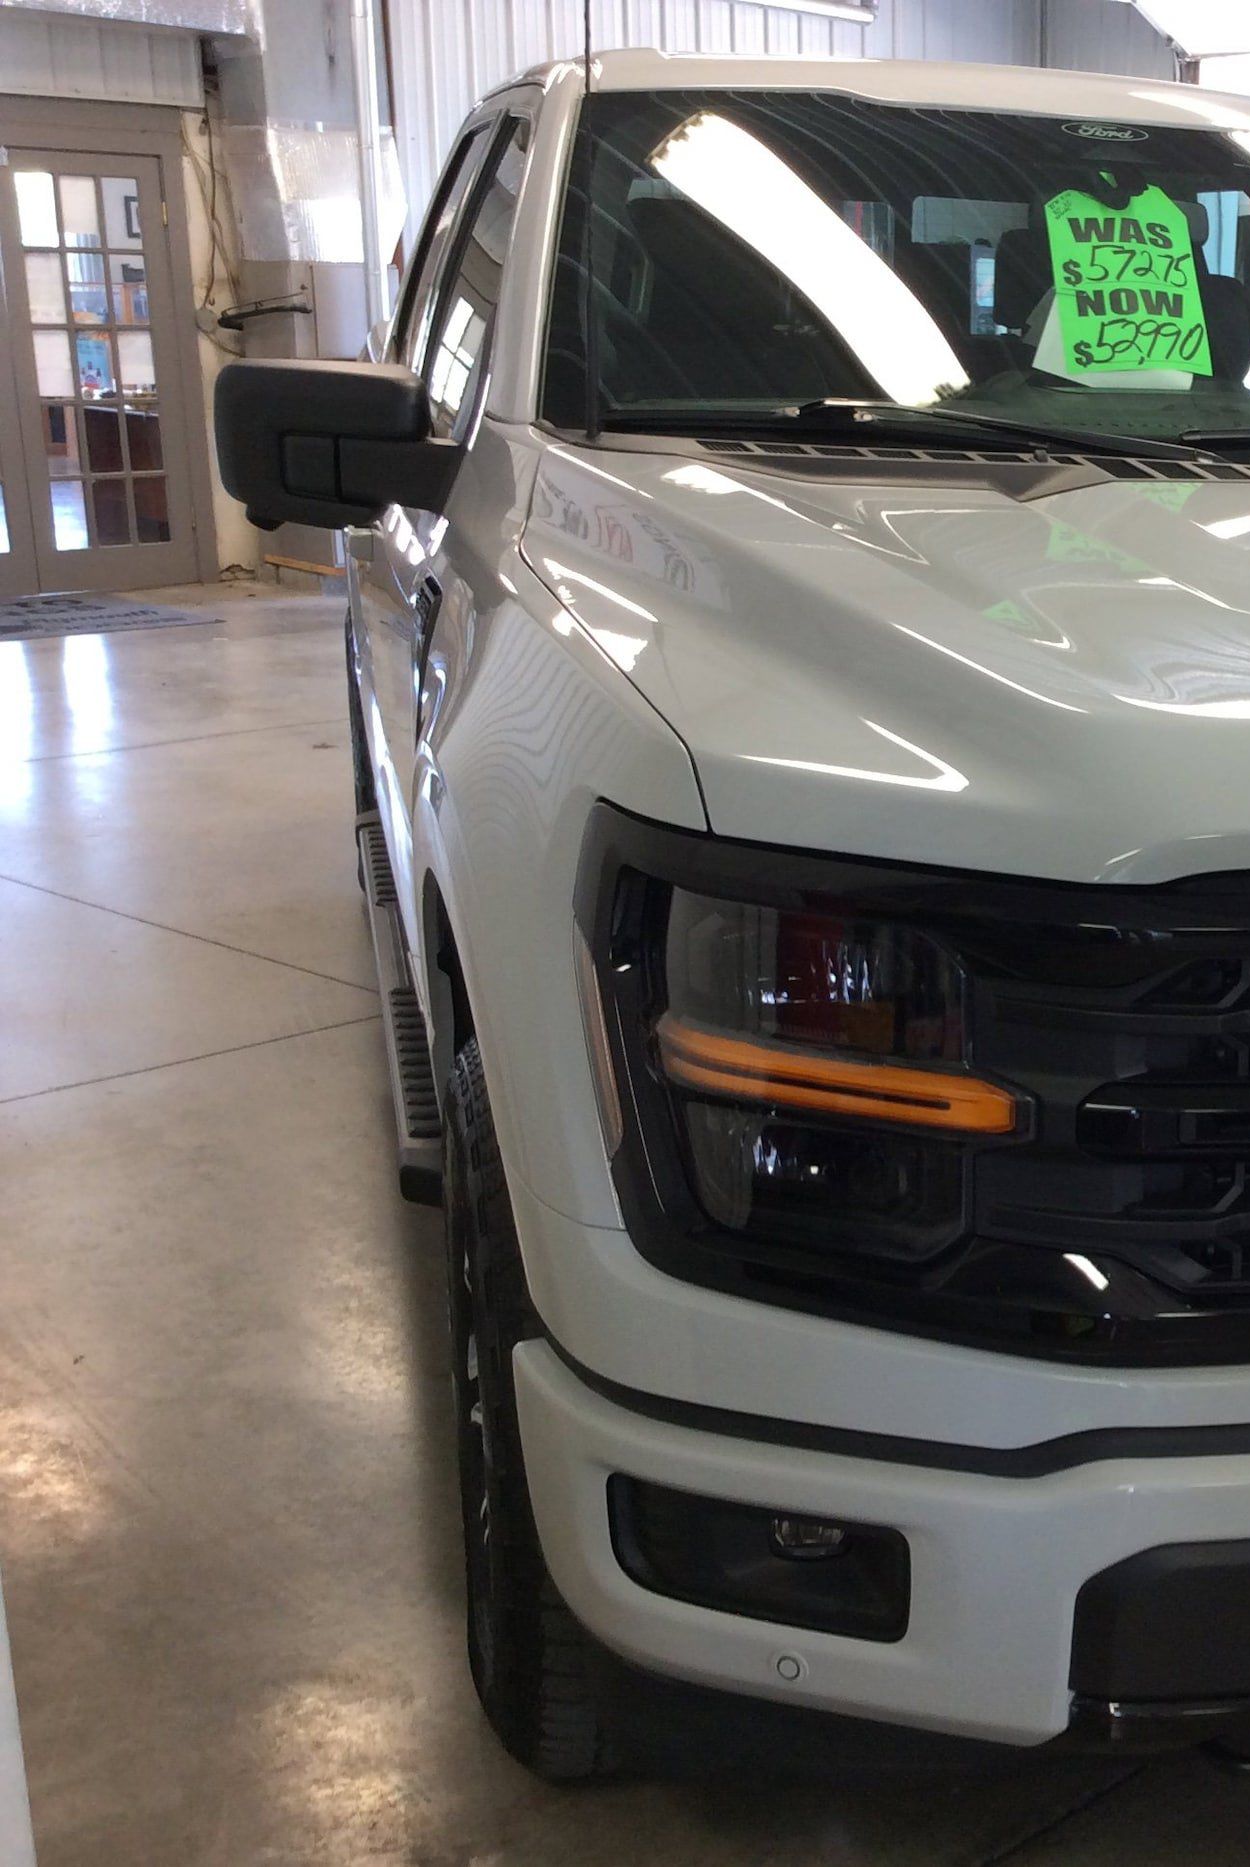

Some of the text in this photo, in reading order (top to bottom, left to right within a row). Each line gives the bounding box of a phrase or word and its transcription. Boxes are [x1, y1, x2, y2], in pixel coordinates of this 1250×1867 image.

[1078, 123, 1134, 139] Ford
[1068, 217, 1173, 249] WAS
[1075, 288, 1183, 318] NOW
